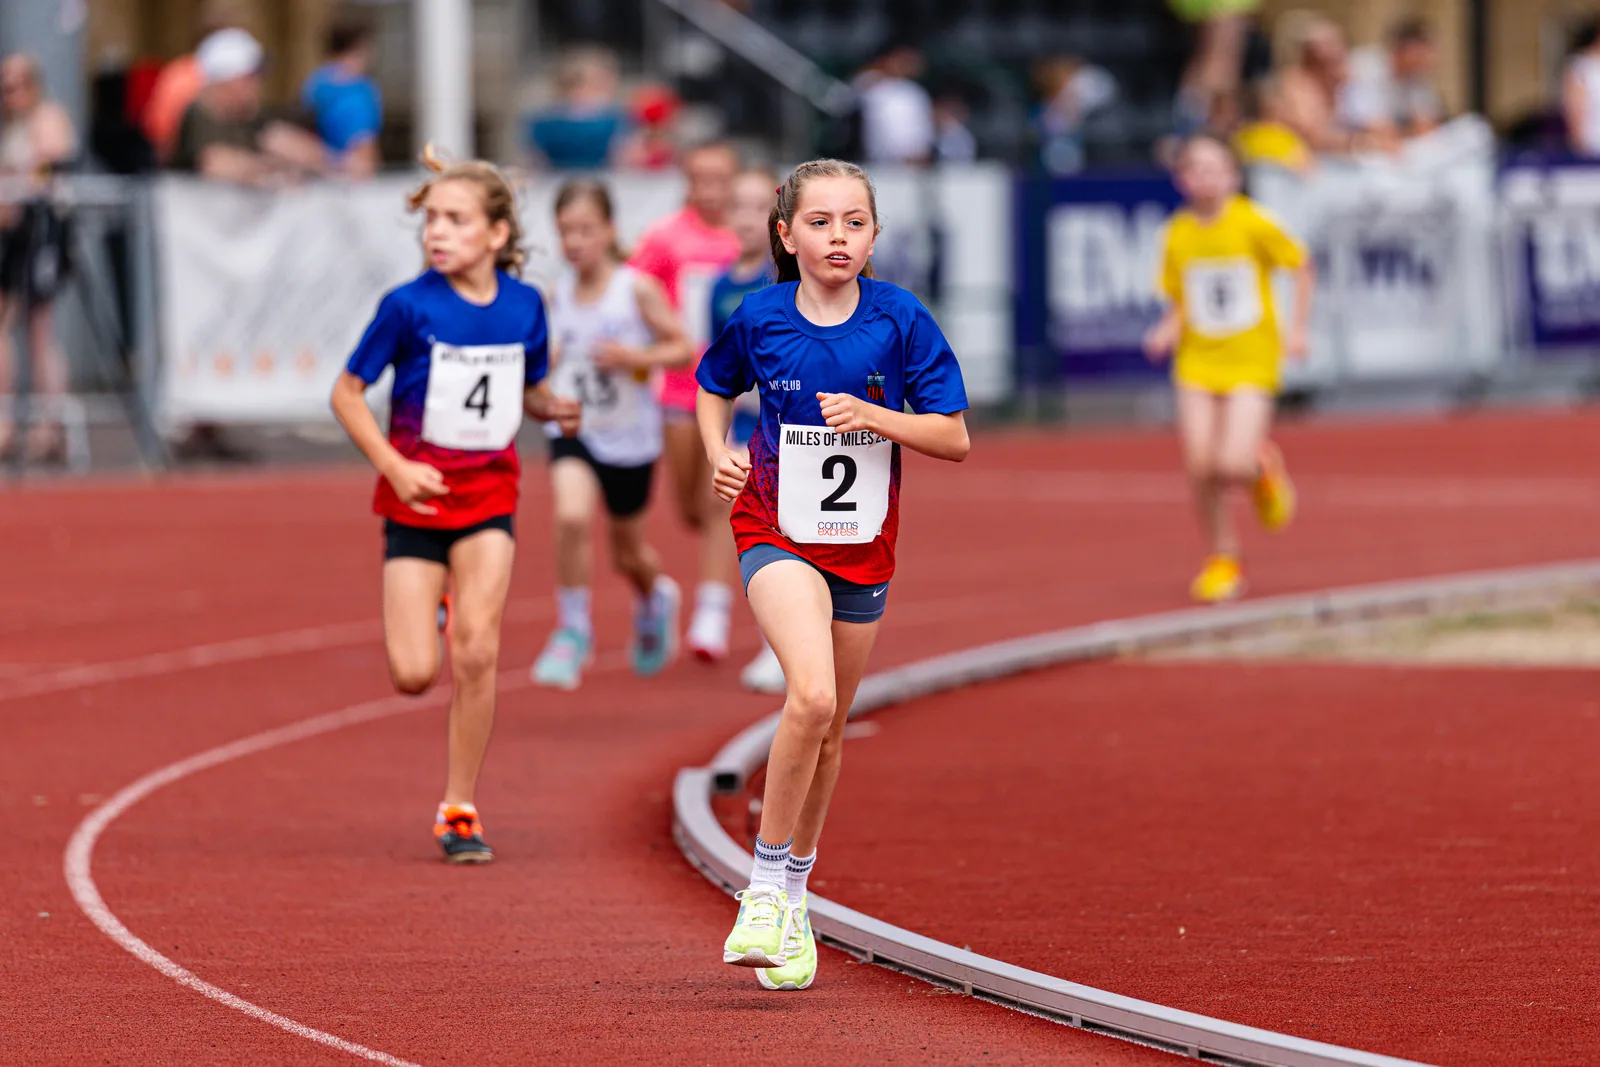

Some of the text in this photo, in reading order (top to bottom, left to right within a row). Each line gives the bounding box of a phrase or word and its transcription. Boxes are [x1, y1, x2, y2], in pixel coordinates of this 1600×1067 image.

[464, 374, 492, 419] 4
[785, 430, 821, 446] MILES
[823, 432, 838, 447] OF
[840, 431, 874, 447] MILES
[820, 454, 857, 512] 2
[817, 521, 859, 530] comms
[817, 528, 859, 537] express
